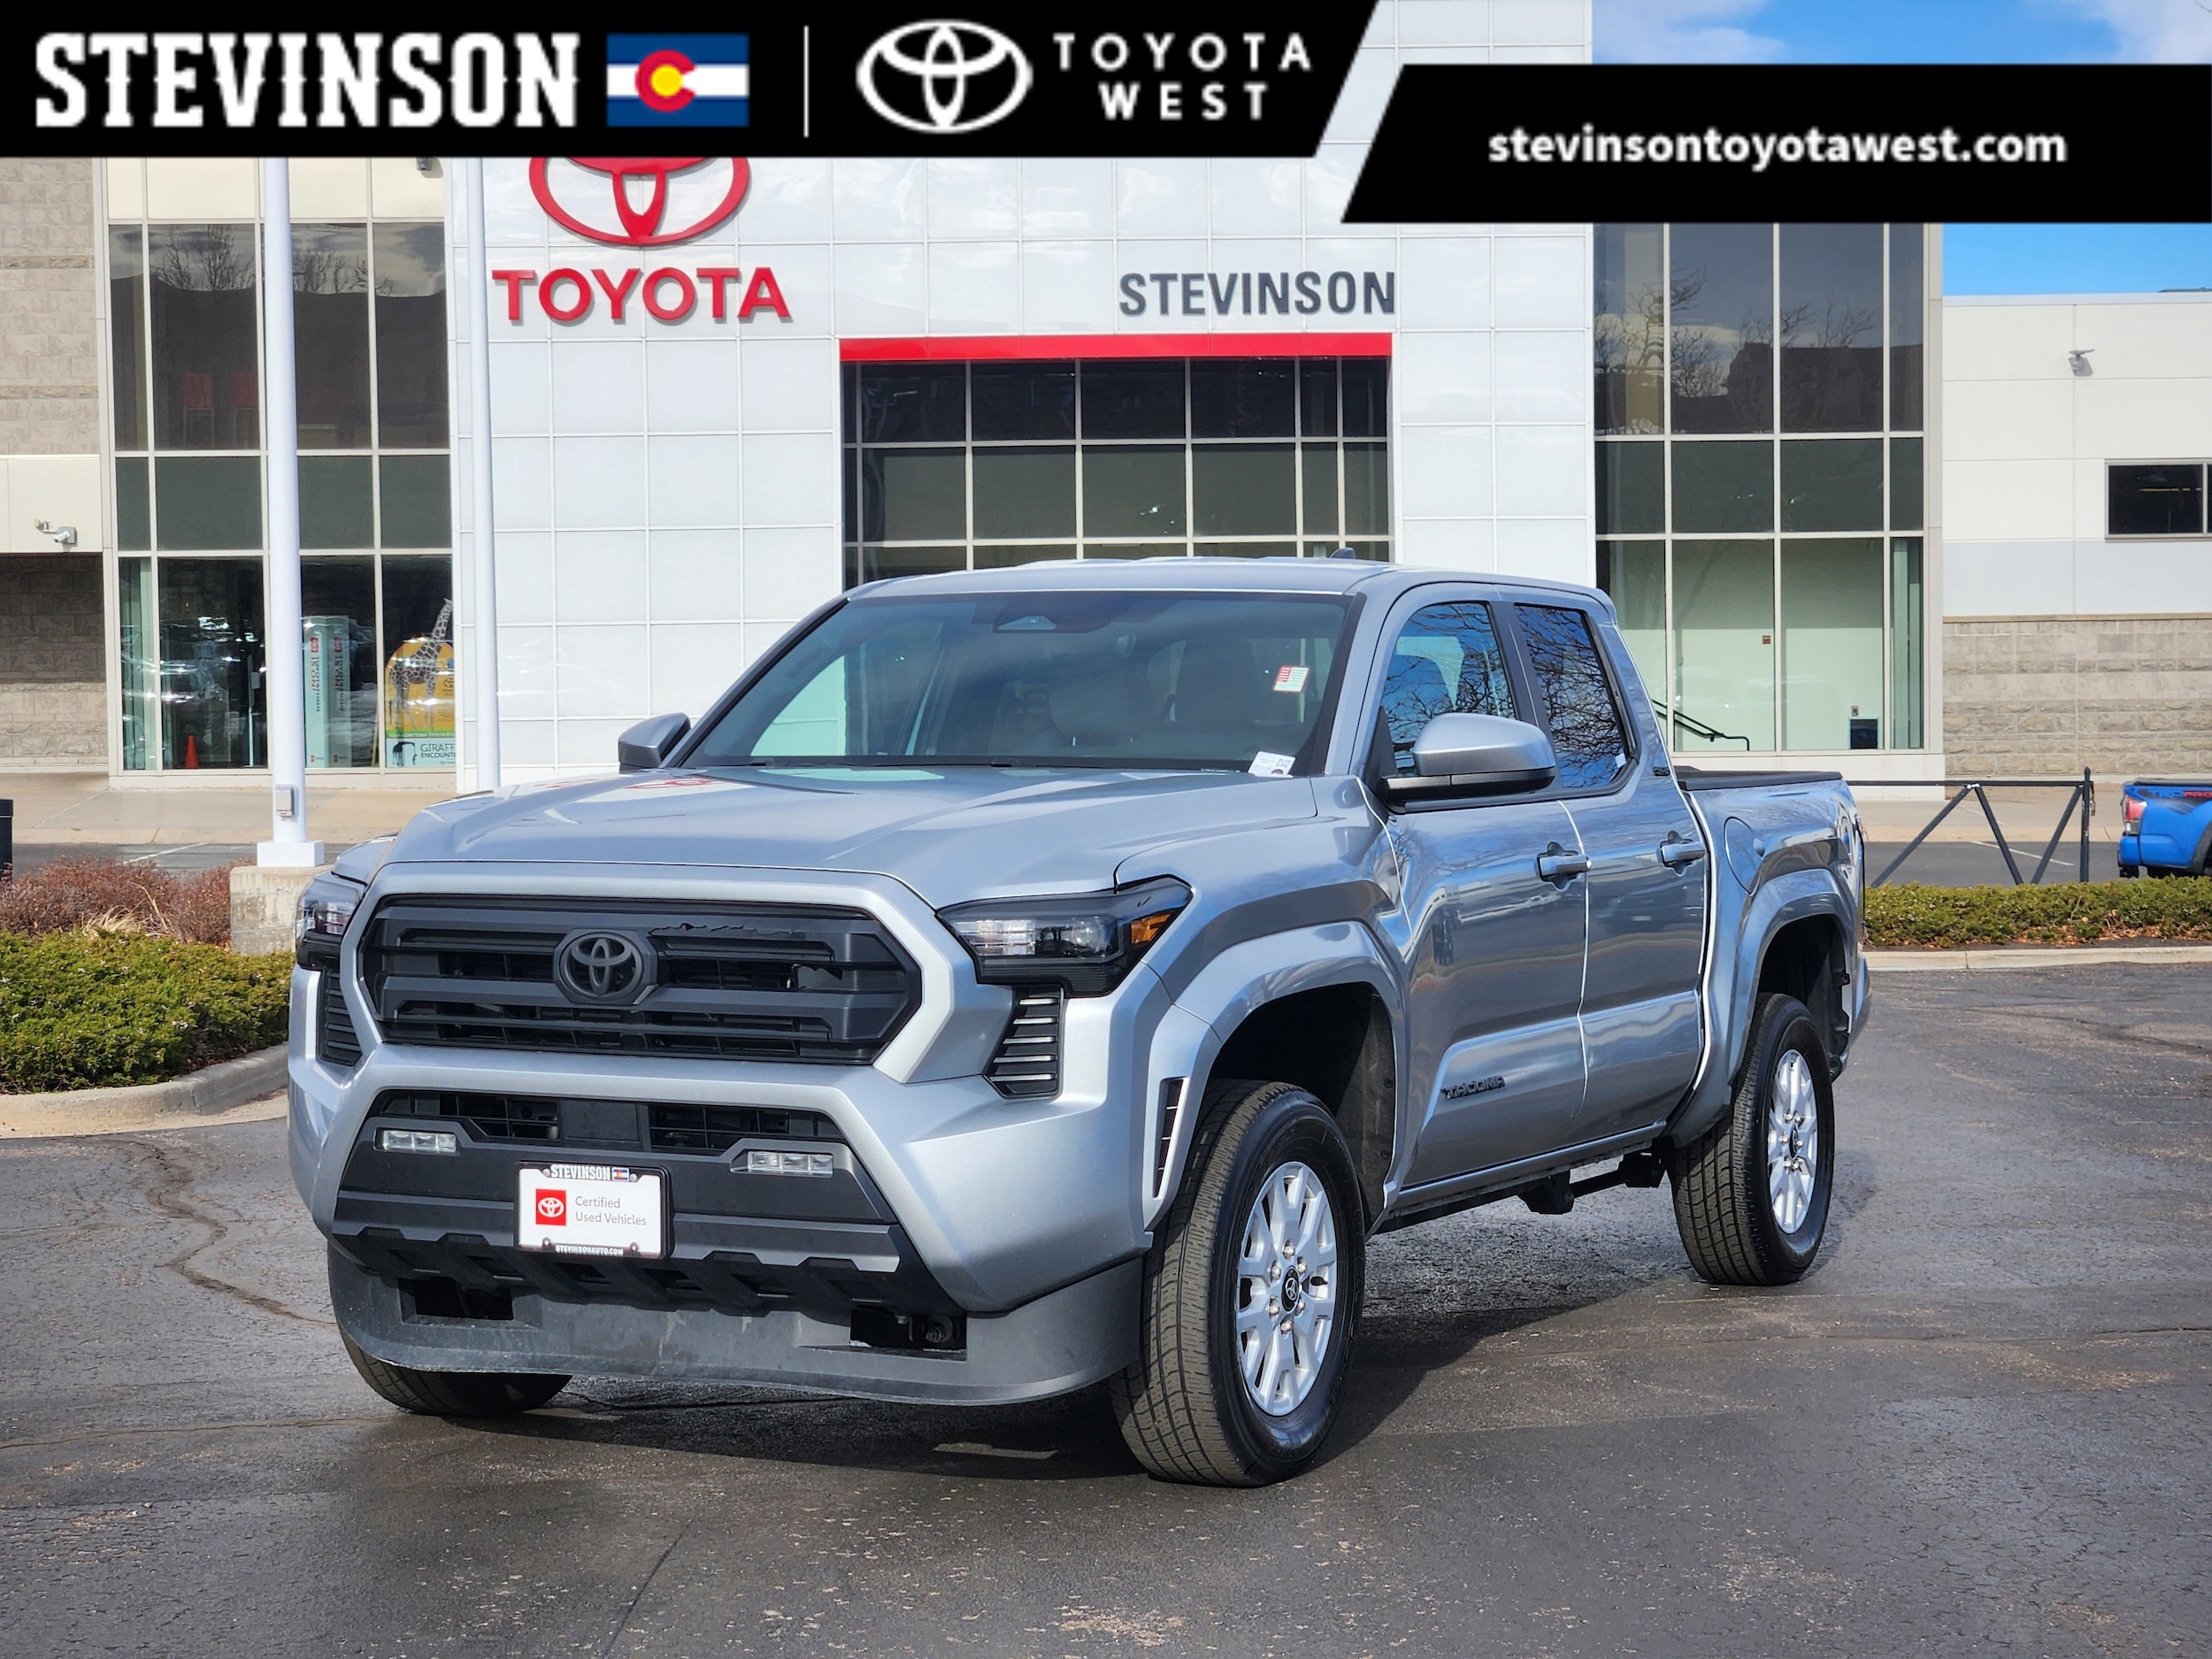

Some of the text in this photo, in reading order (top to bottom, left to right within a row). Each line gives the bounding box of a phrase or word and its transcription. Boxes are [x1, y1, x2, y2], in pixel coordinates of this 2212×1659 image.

[492, 267, 791, 323] TOYOTA
[1119, 271, 1395, 316] STEVINSON
[1441, 1076, 1506, 1099] TACOMA
[550, 1164, 611, 1181] STEVINSON
[575, 1195, 620, 1209] Certified
[575, 1211, 647, 1226] Used Vehicles
[555, 1244, 624, 1256] STEVINSONAUTO.COM
